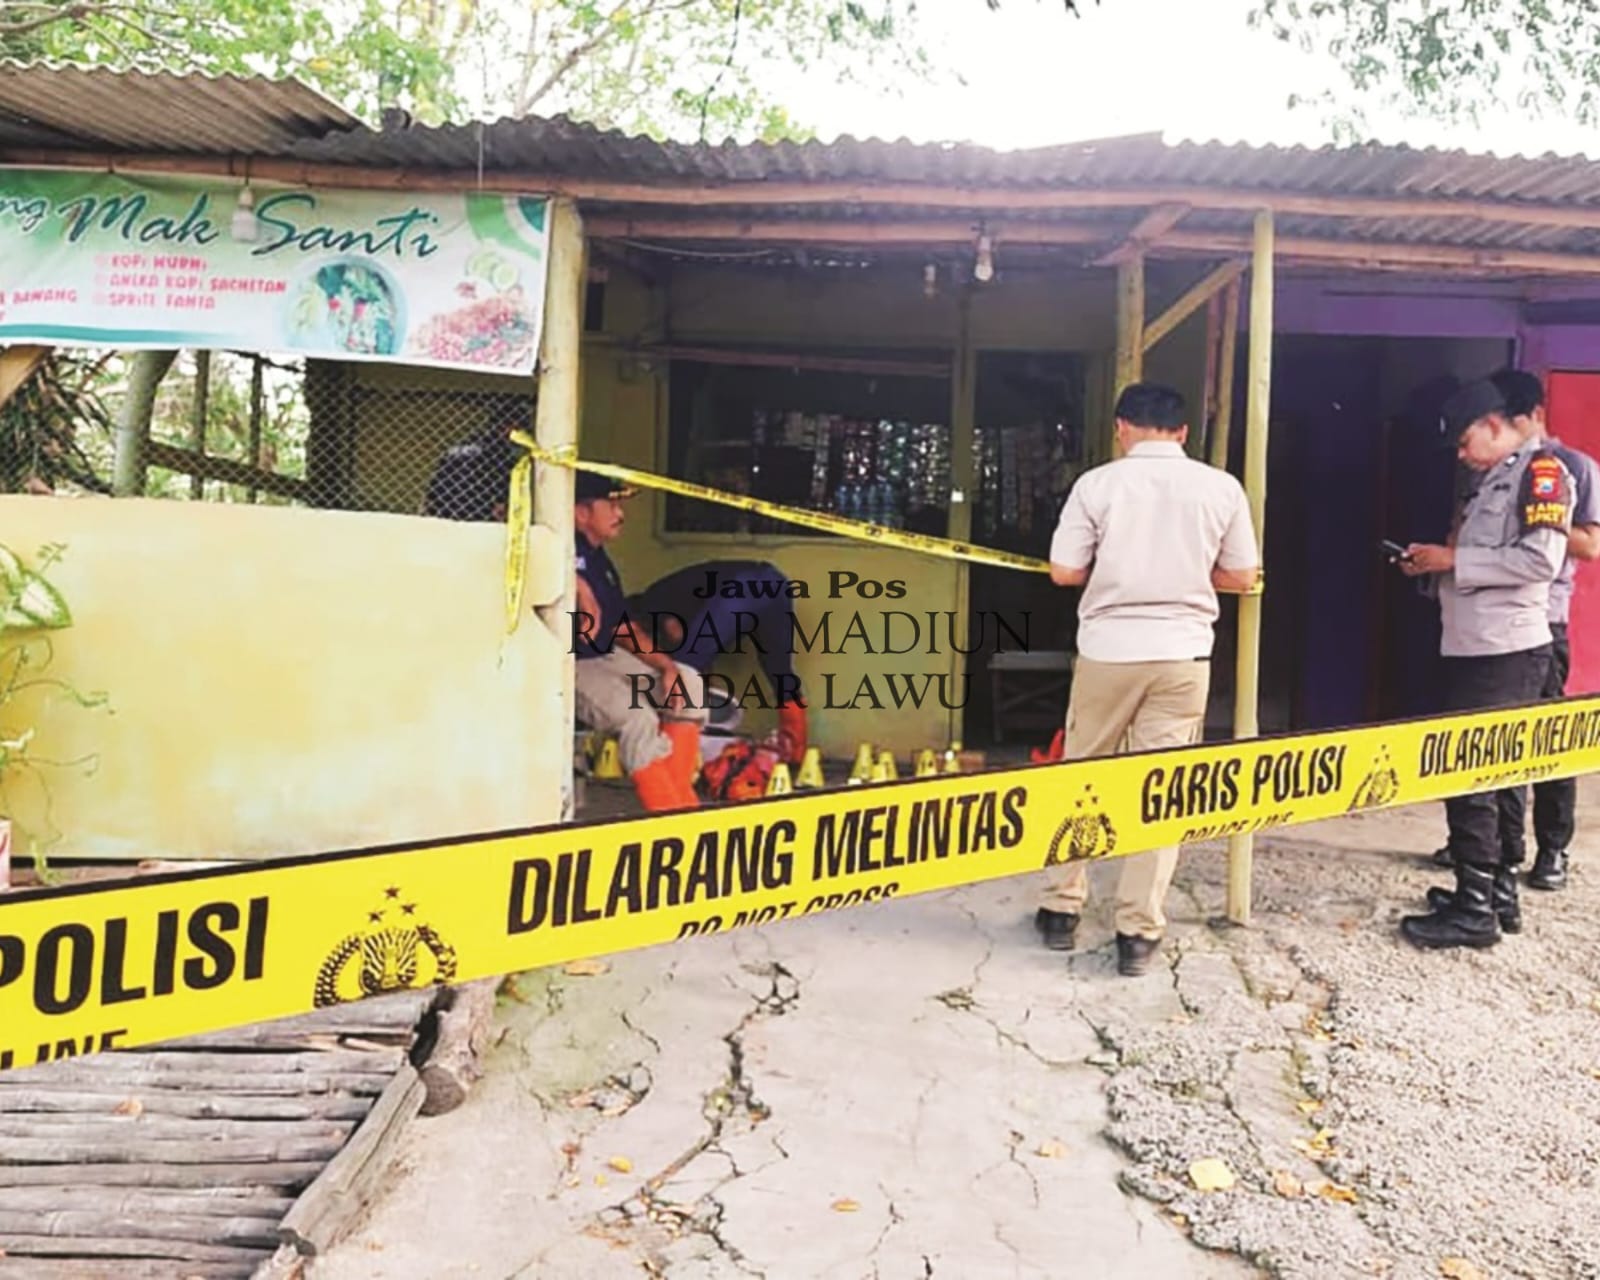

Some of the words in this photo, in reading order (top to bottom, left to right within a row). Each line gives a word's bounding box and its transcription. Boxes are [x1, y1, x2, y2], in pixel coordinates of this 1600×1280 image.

[58, 191, 220, 244] Mak
[251, 193, 438, 257] Santi
[1141, 757, 1242, 825] GARIS
[1251, 745, 1348, 808] POLISI
[1419, 719, 1527, 779] DILARANG
[506, 818, 798, 936] DILARANG
[811, 786, 1028, 881] MELINTAS
